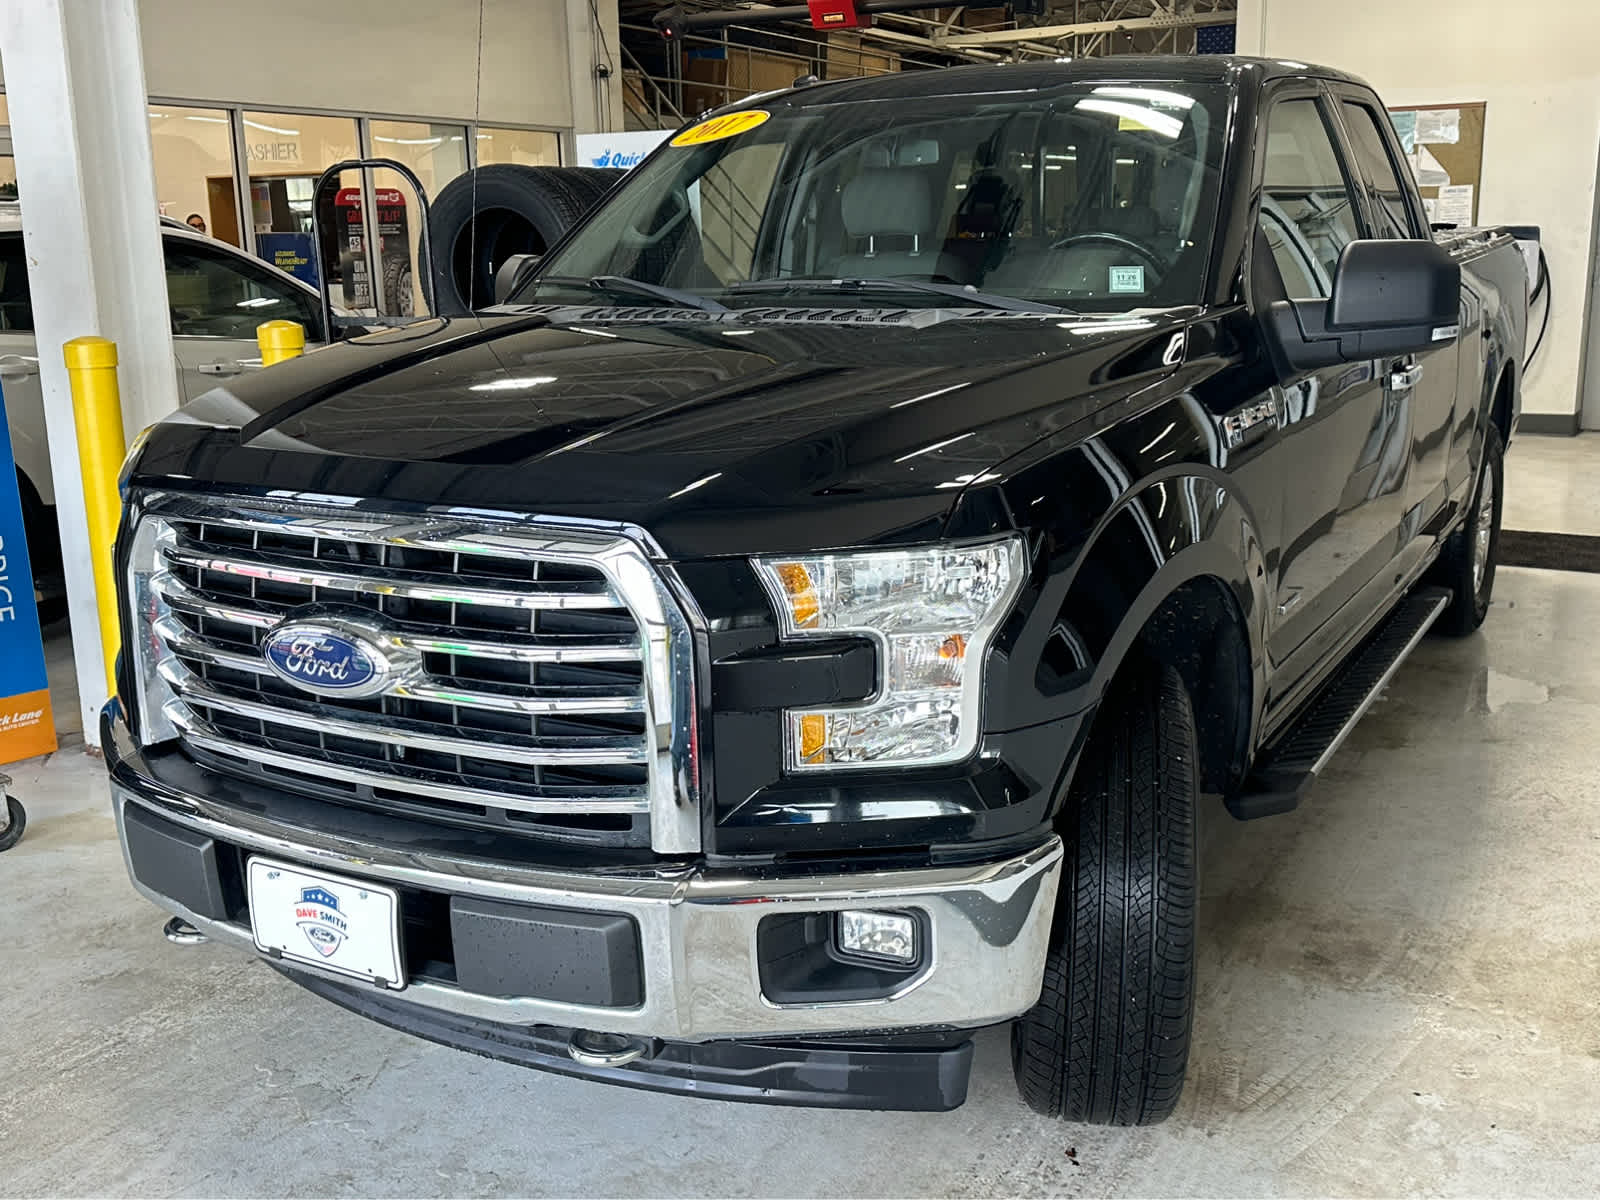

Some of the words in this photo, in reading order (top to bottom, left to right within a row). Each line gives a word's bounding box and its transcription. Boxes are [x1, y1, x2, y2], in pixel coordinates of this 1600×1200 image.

[246, 143, 298, 161] ASHIER
[286, 638, 350, 681] Ford
[12, 709, 43, 723] Lane
[296, 907, 318, 919] DAVE
[319, 910, 347, 931] SMITH
